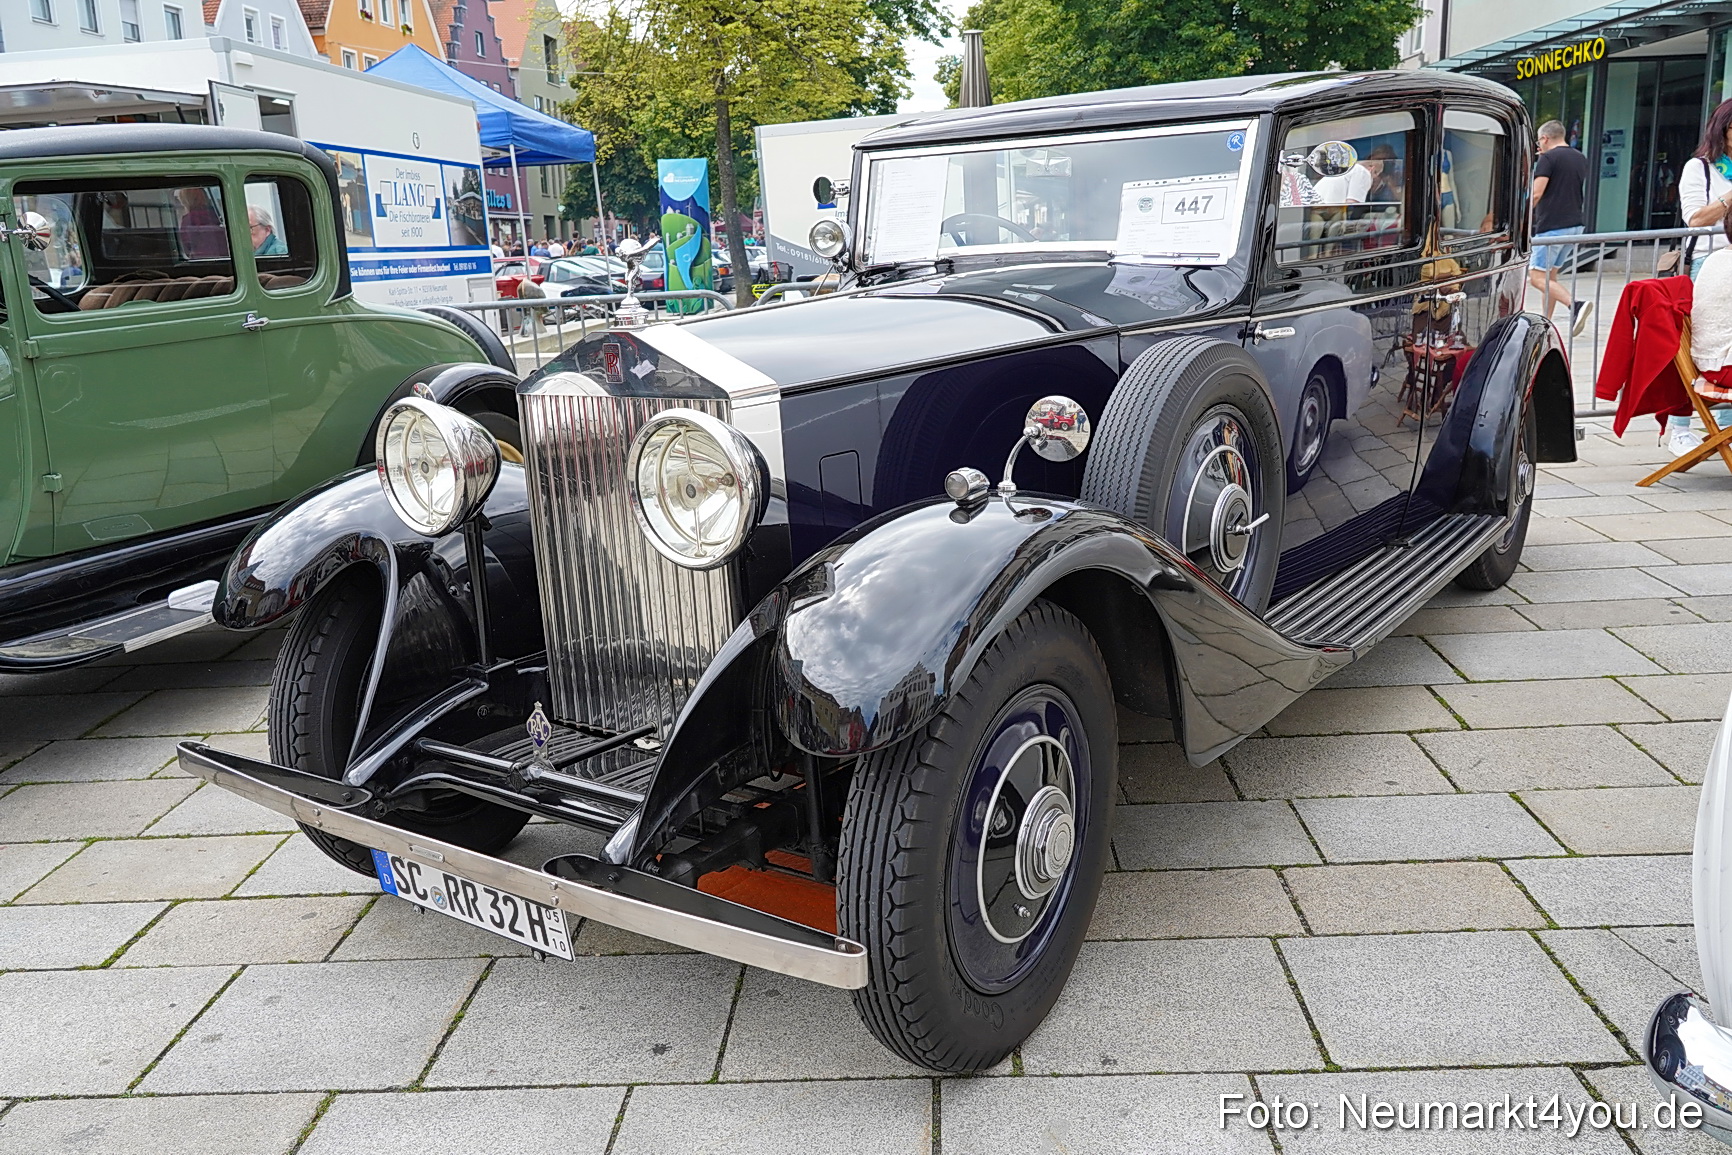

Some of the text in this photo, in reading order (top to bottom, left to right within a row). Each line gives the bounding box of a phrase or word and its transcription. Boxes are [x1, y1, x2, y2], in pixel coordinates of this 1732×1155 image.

[1516, 37, 1606, 80] SONNECHKO
[393, 181, 425, 207] LANG
[1174, 195, 1214, 216] 447
[389, 210, 399, 222] Die
[401, 226, 423, 238] seit 1900
[384, 873, 392, 885] D
[390, 856, 550, 947] SC RR 32H
[545, 909, 560, 923] 05
[552, 938, 566, 952] 10
